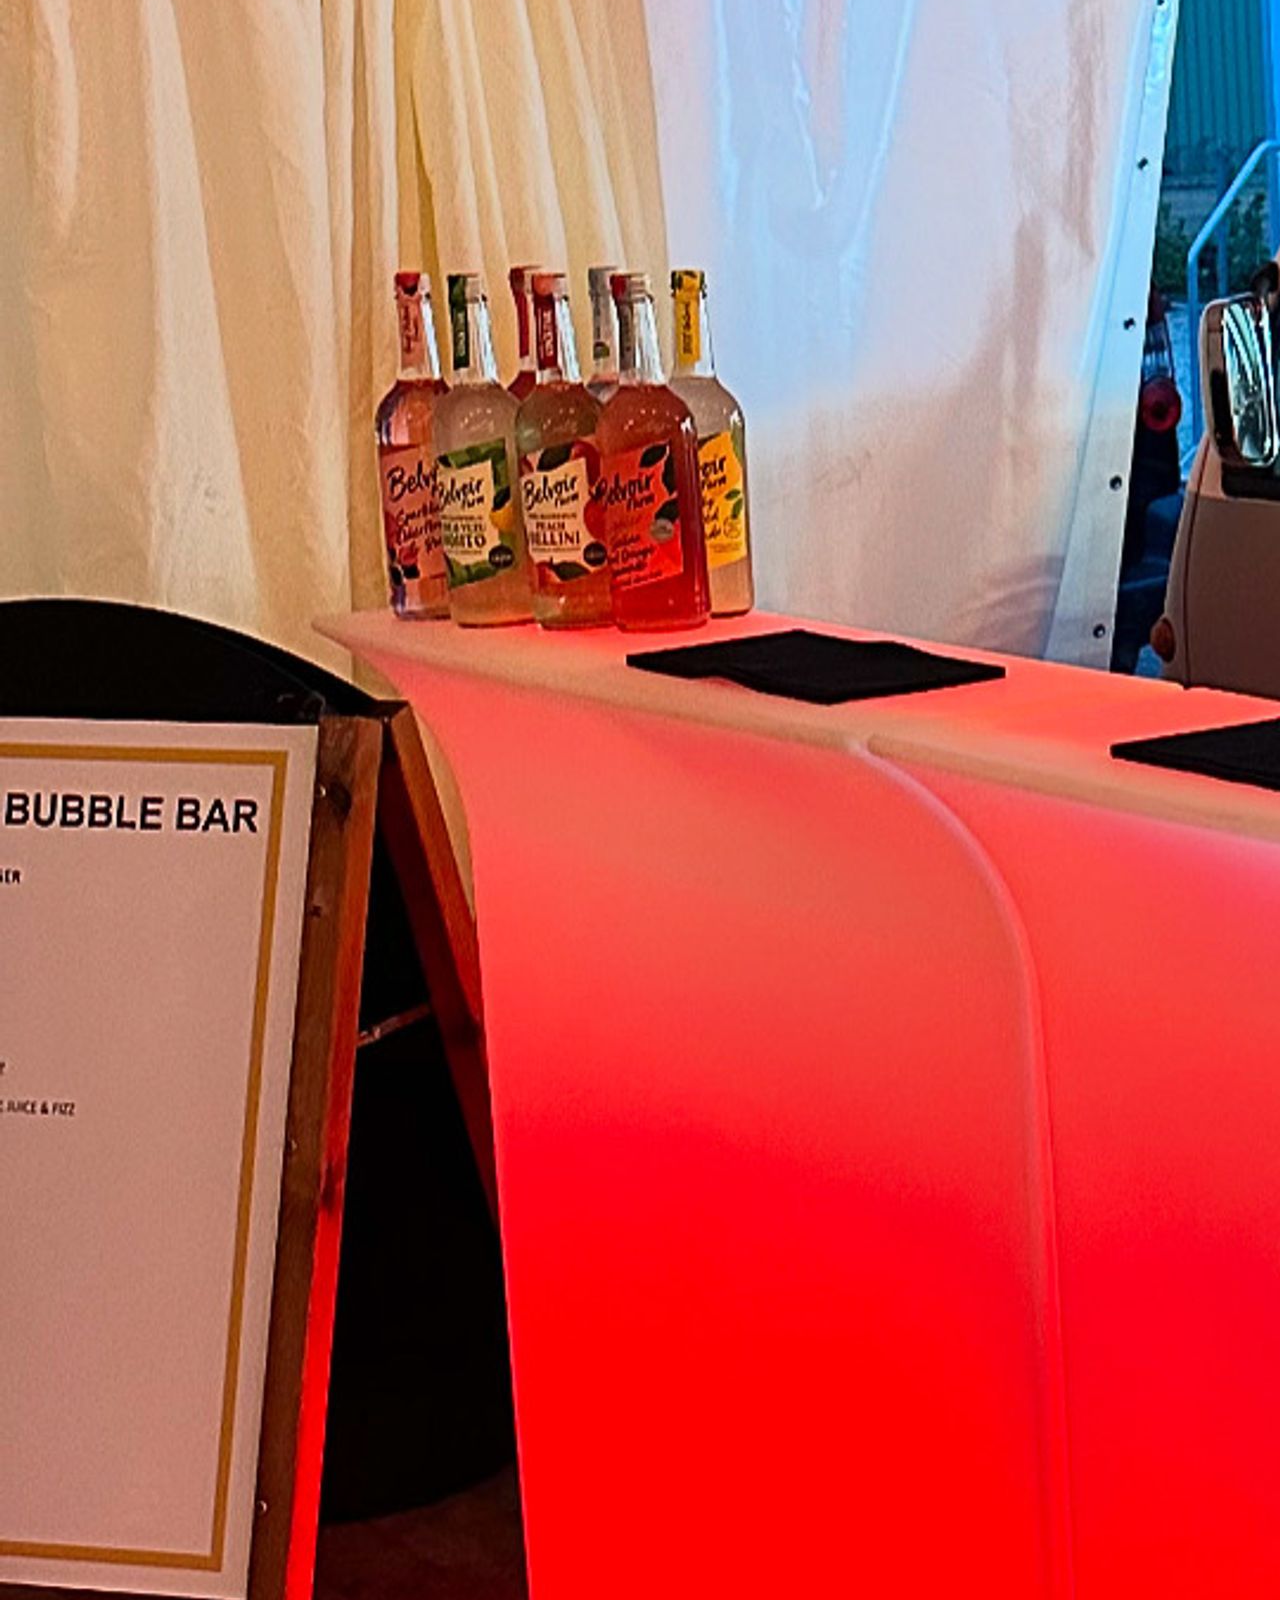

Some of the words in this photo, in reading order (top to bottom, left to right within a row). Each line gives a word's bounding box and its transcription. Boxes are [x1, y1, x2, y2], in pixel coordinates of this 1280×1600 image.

[524, 473, 578, 511] Belvoir
[4, 791, 164, 831] BUBBLE
[175, 796, 259, 834] BAR
